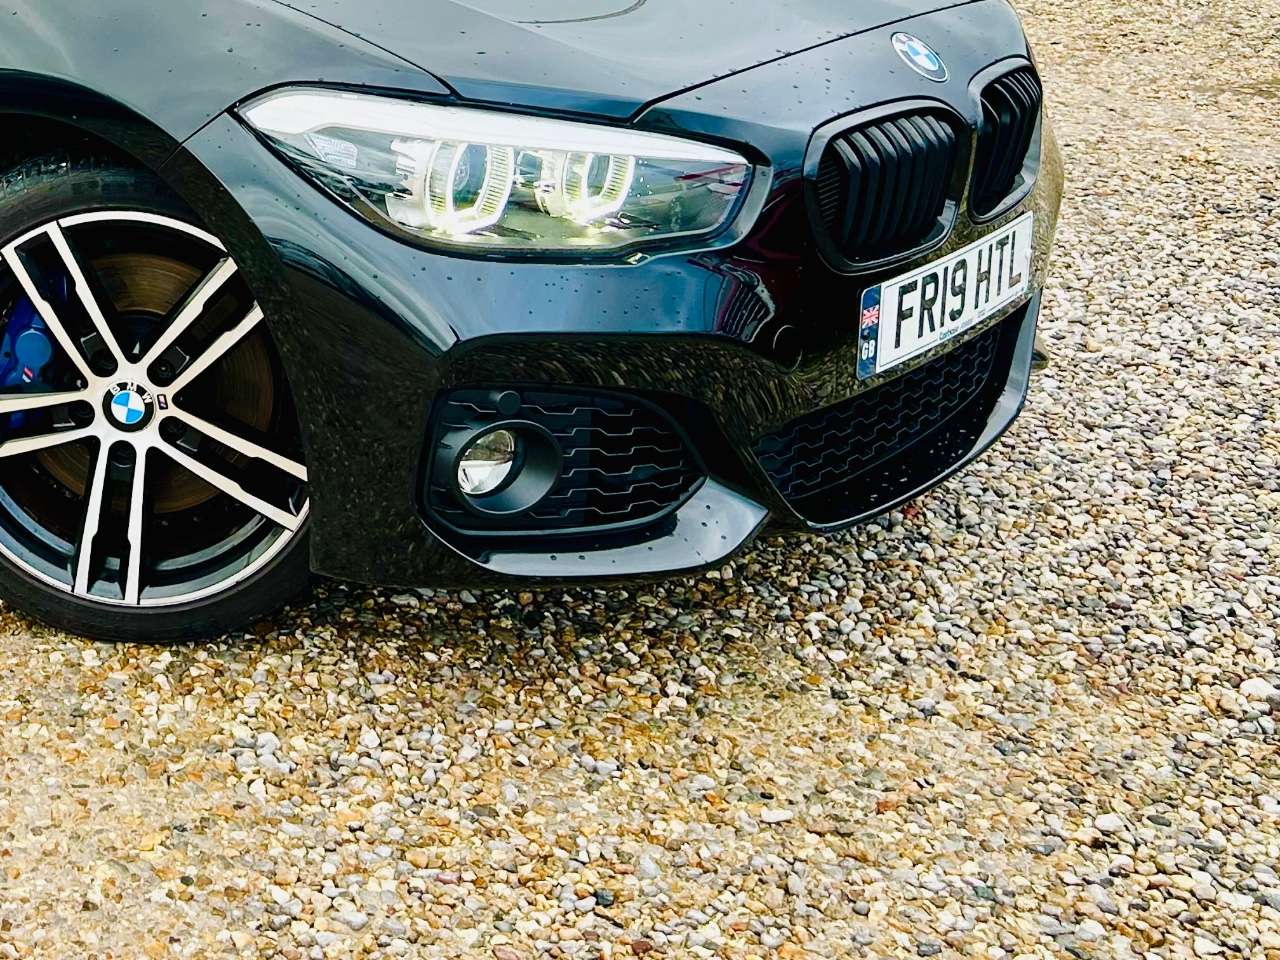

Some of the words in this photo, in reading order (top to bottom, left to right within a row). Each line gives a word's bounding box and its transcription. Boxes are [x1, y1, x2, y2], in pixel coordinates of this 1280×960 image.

[894, 257, 969, 349] FR19
[974, 230, 1022, 310] HTL
[861, 339, 875, 361] GB
